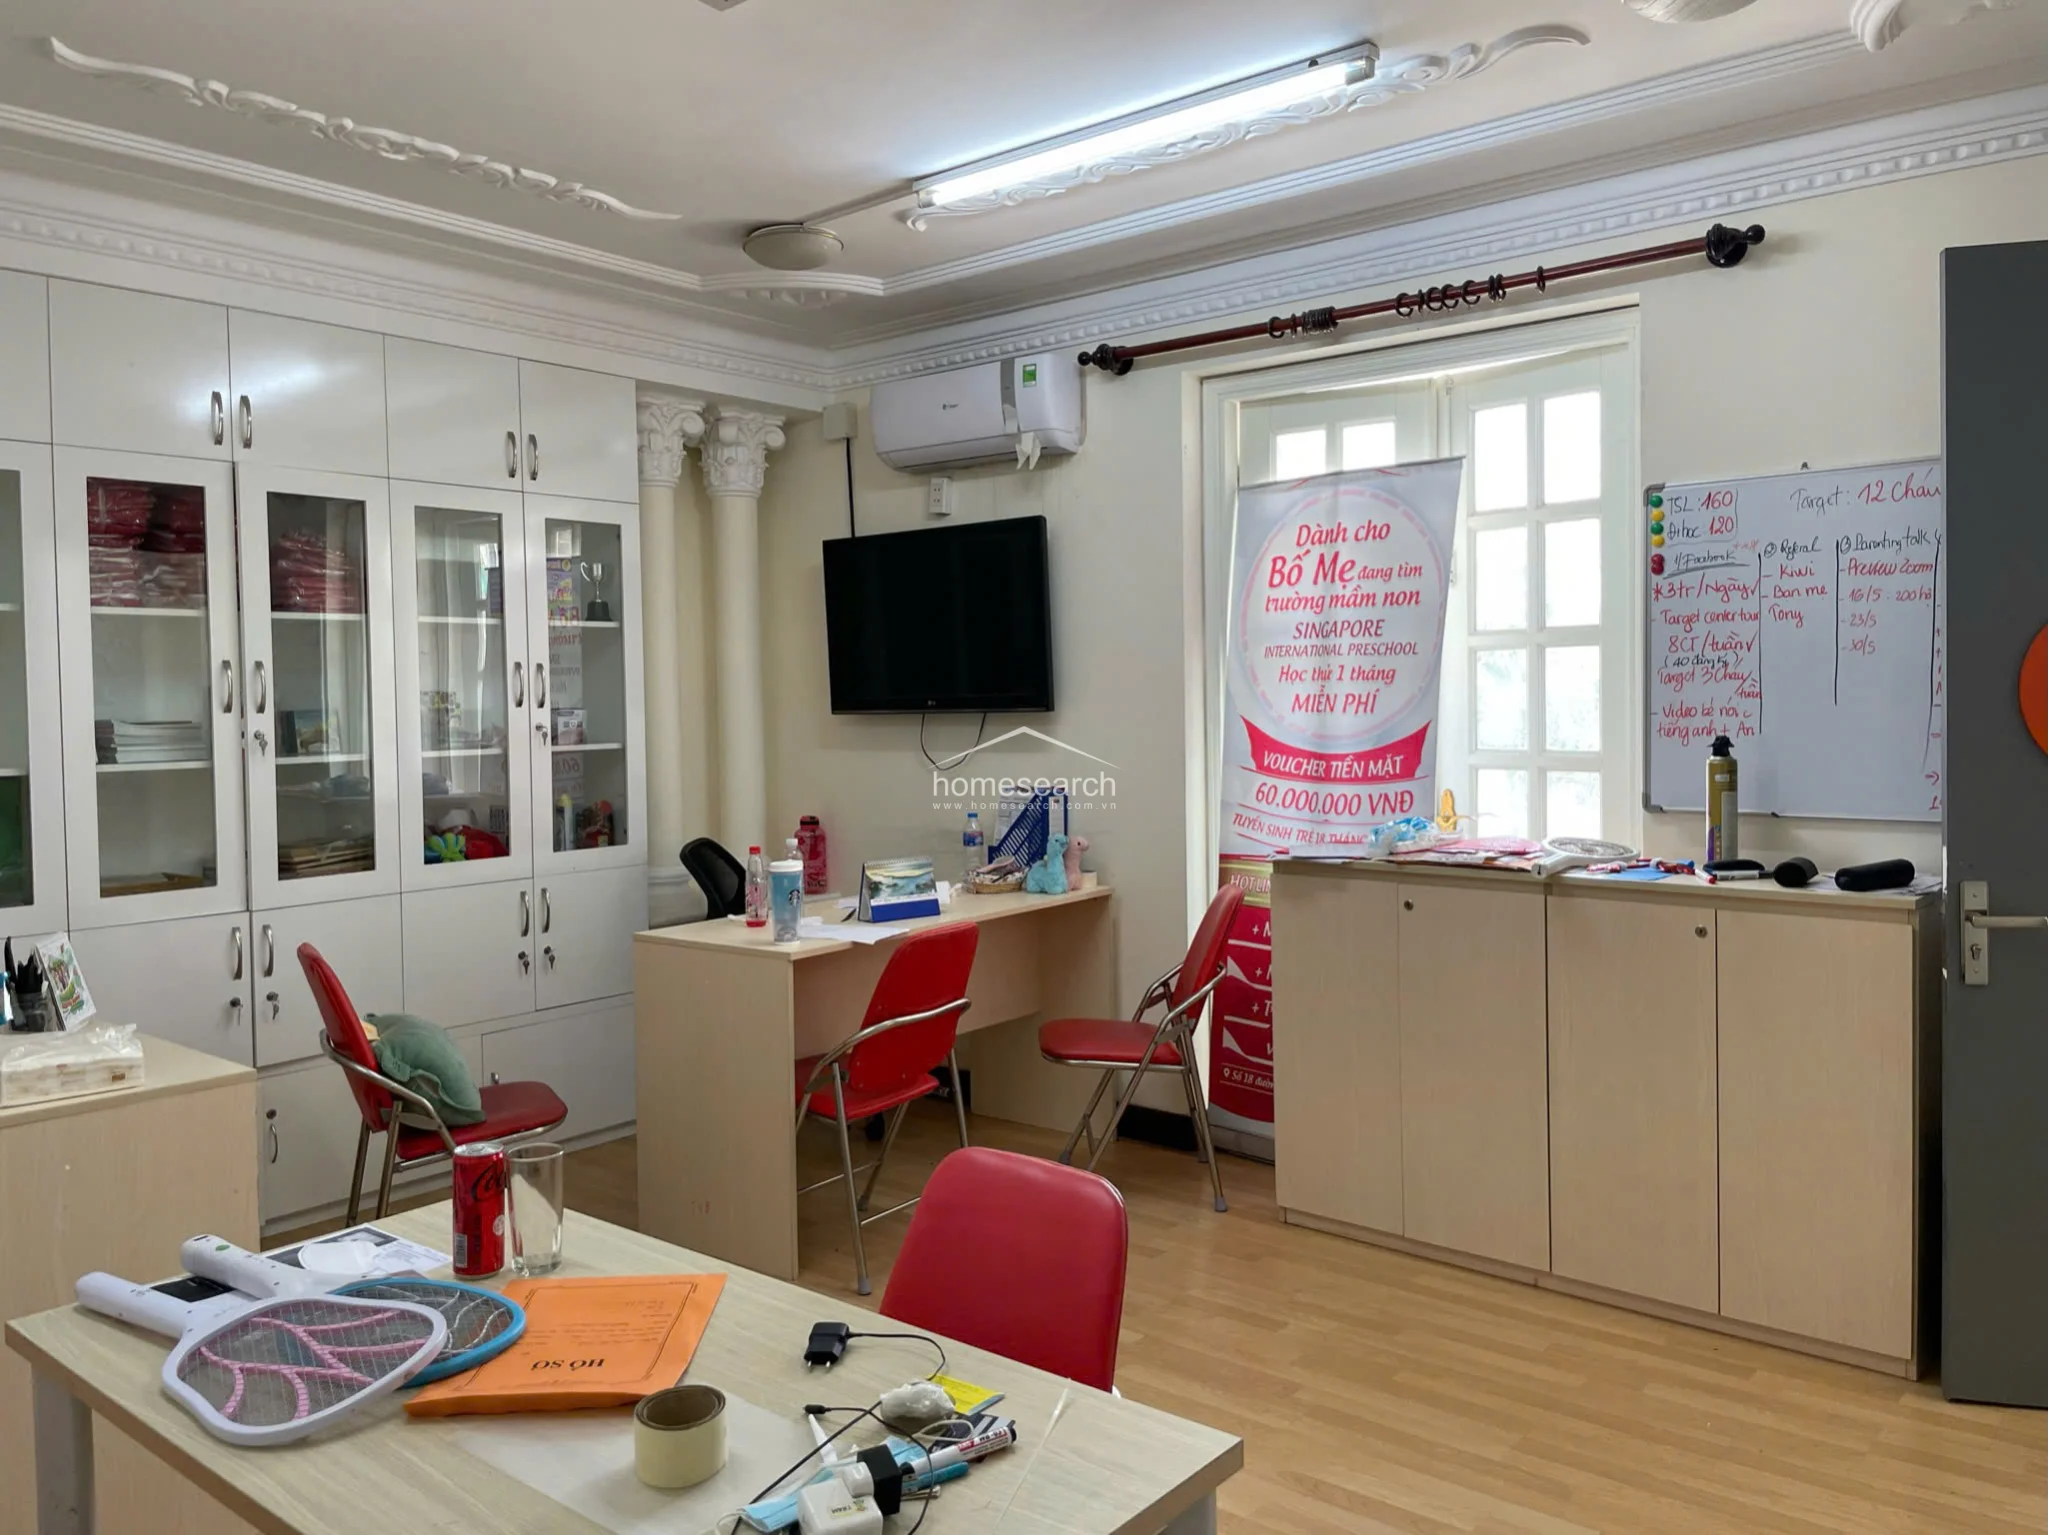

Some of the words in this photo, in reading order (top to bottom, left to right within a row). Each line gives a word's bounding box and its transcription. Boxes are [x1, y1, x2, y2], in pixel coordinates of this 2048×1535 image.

[1701, 490, 1733, 510] 160
[1857, 479, 1887, 504] 12
[1296, 522, 1347, 547] Dành
[1354, 520, 1390, 541] cho
[1709, 515, 1734, 535] 120
[1268, 549, 1310, 588] Bố
[1313, 551, 1356, 589] Mẹ
[1358, 566, 1393, 583] đang
[1265, 591, 1326, 615] trường
[1329, 585, 1376, 608] mầm
[1382, 590, 1420, 607] non
[1768, 603, 1803, 629] Tony
[1293, 619, 1385, 640] SINGAPORE
[1264, 643, 1343, 659] INTERNATIONAL
[1347, 641, 1419, 656] PRESCHOOL
[1278, 664, 1307, 685] Học
[1336, 664, 1345, 681] 1
[1350, 664, 1396, 685] tháng
[1291, 685, 1337, 713] MIỄN
[1342, 688, 1380, 714] PHÍ
[1692, 719, 1717, 737] anh
[1263, 750, 1326, 778] VOUCHER
[1330, 755, 1364, 779] TIỀN
[1368, 754, 1404, 779] MẶT
[1256, 782, 1362, 816] 60.000.000
[1368, 789, 1414, 816] VNĐ
[1266, 823, 1293, 841] SINH
